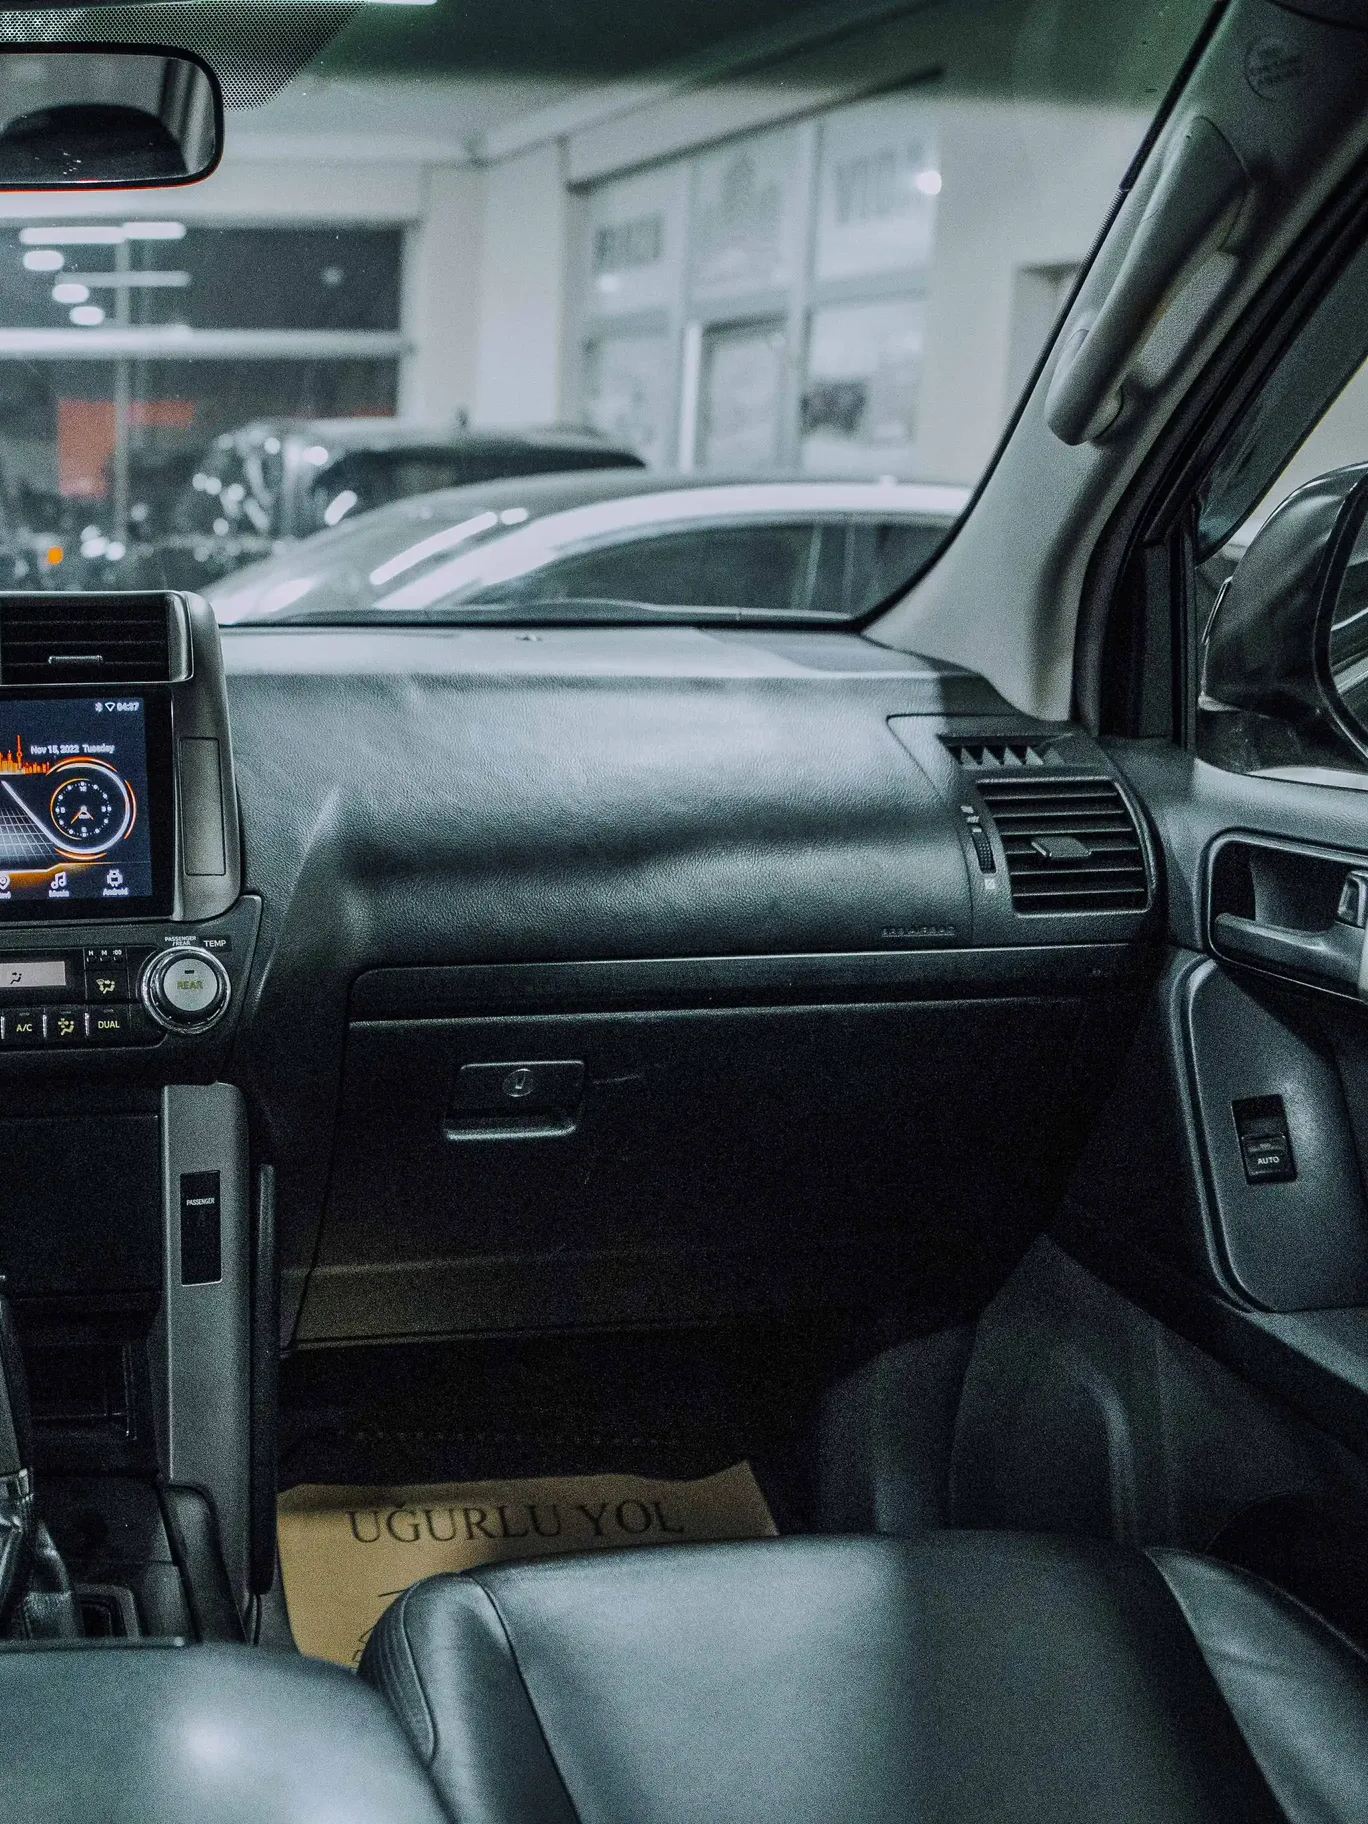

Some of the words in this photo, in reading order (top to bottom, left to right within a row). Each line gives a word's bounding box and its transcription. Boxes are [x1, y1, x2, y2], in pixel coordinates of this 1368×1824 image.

[30, 745, 47, 754] Nov
[60, 744, 80, 754] 2022
[82, 743, 115, 754] Tuesday
[102, 888, 129, 896] Android
[203, 939, 227, 947] TEMP
[176, 980, 203, 990] REAR
[16, 1023, 33, 1032] A/C
[98, 1020, 120, 1029] DUAL
[1257, 1156, 1280, 1165] AUTO
[186, 1197, 215, 1206] PASSENGER
[345, 1501, 563, 1544] UĞURLU
[576, 1499, 684, 1537] YOL
